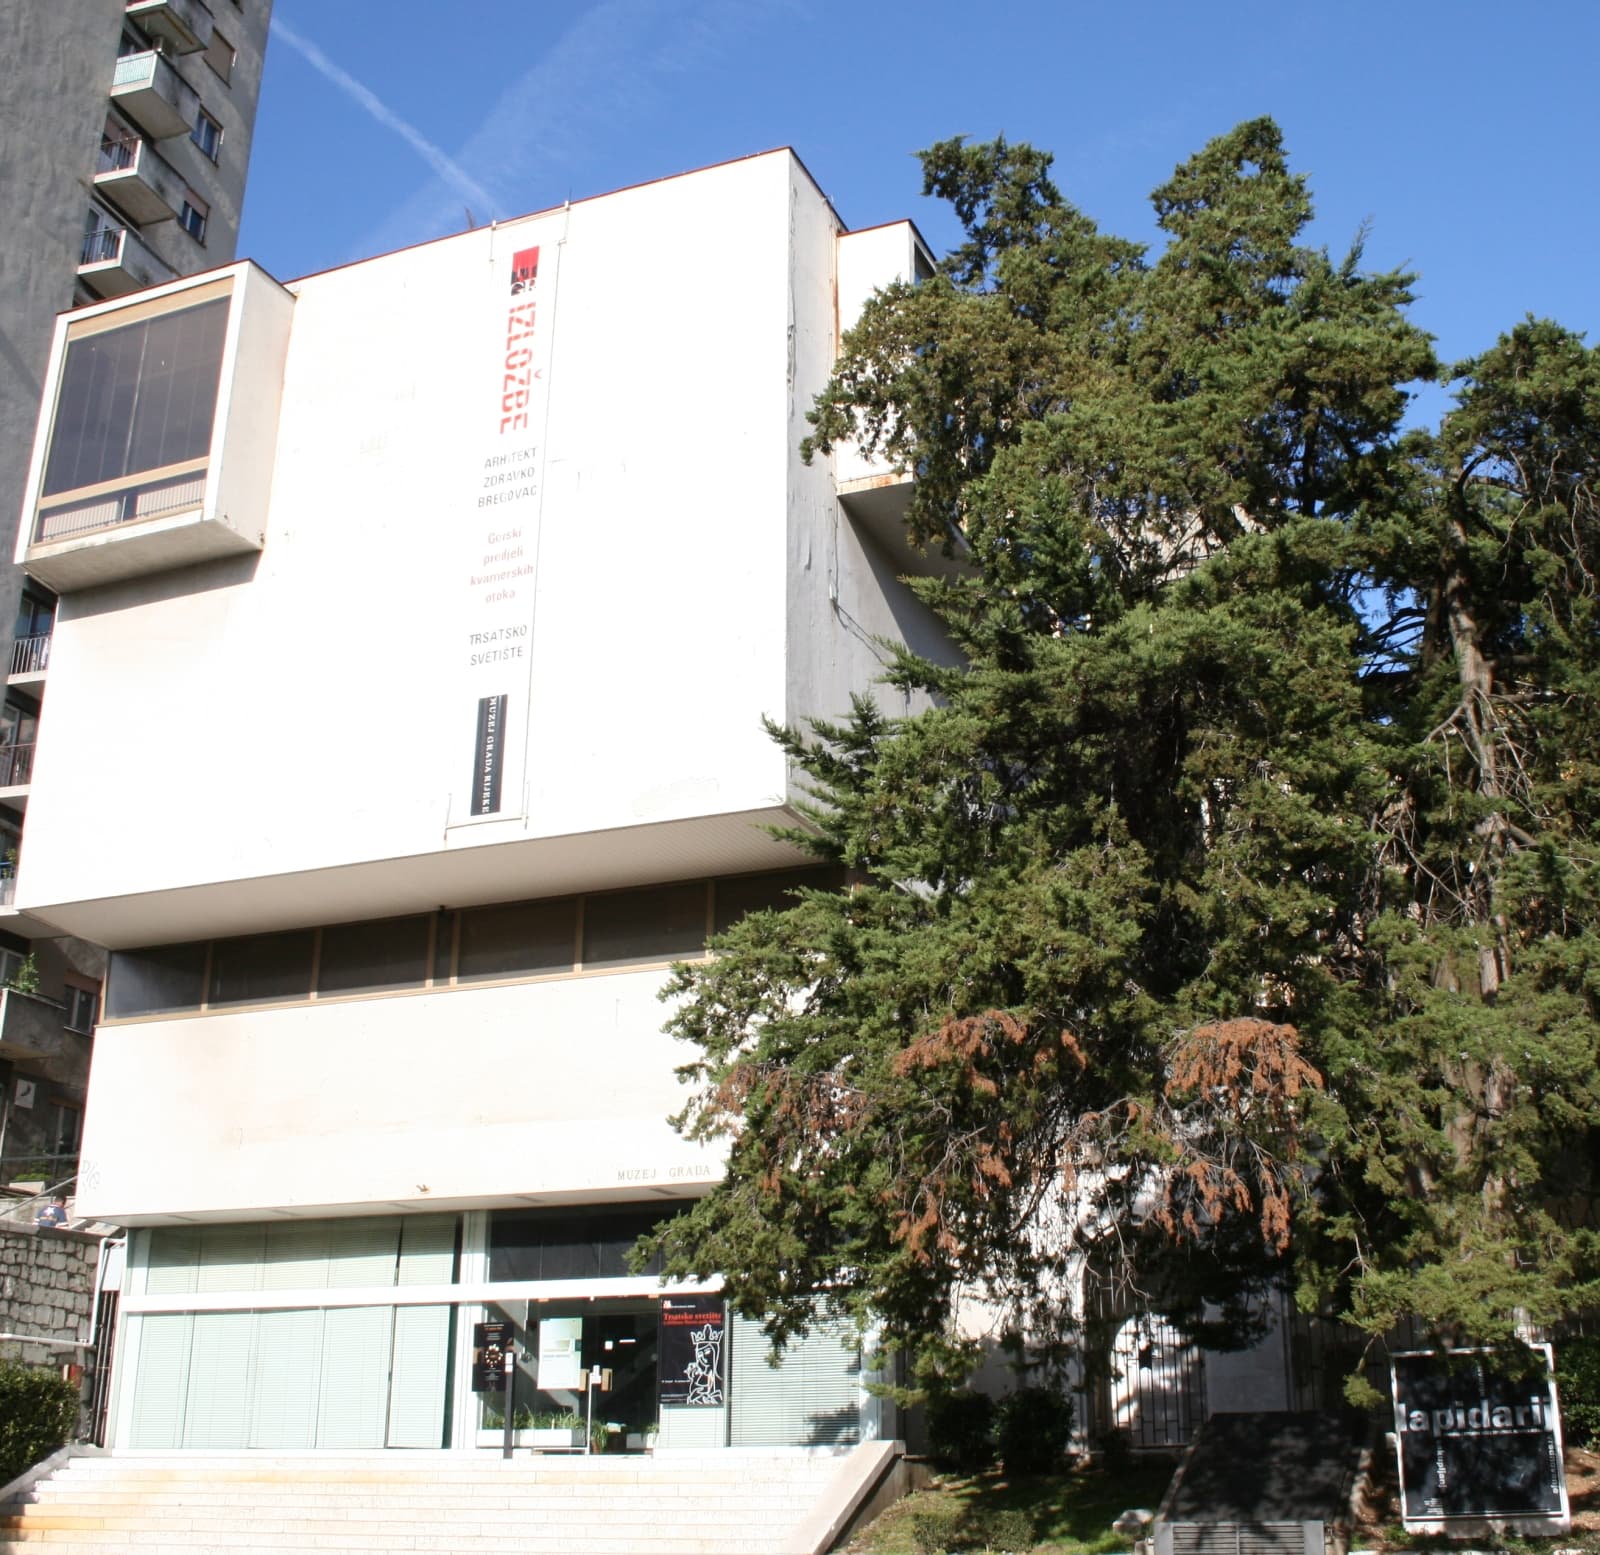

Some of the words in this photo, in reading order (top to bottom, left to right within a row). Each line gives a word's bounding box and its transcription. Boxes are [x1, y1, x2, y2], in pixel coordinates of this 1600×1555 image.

[484, 447, 538, 469] ARHITEKT
[483, 466, 535, 488] ZDRAVKO
[478, 485, 538, 508] BREGOVAC
[487, 528, 522, 544] Gorski
[485, 588, 516, 604] otoka
[469, 624, 527, 646] TRSATSKO
[484, 736, 495, 773] GRADA
[617, 1168, 657, 1181] MUZEJ
[668, 1165, 711, 1178] GRADA
